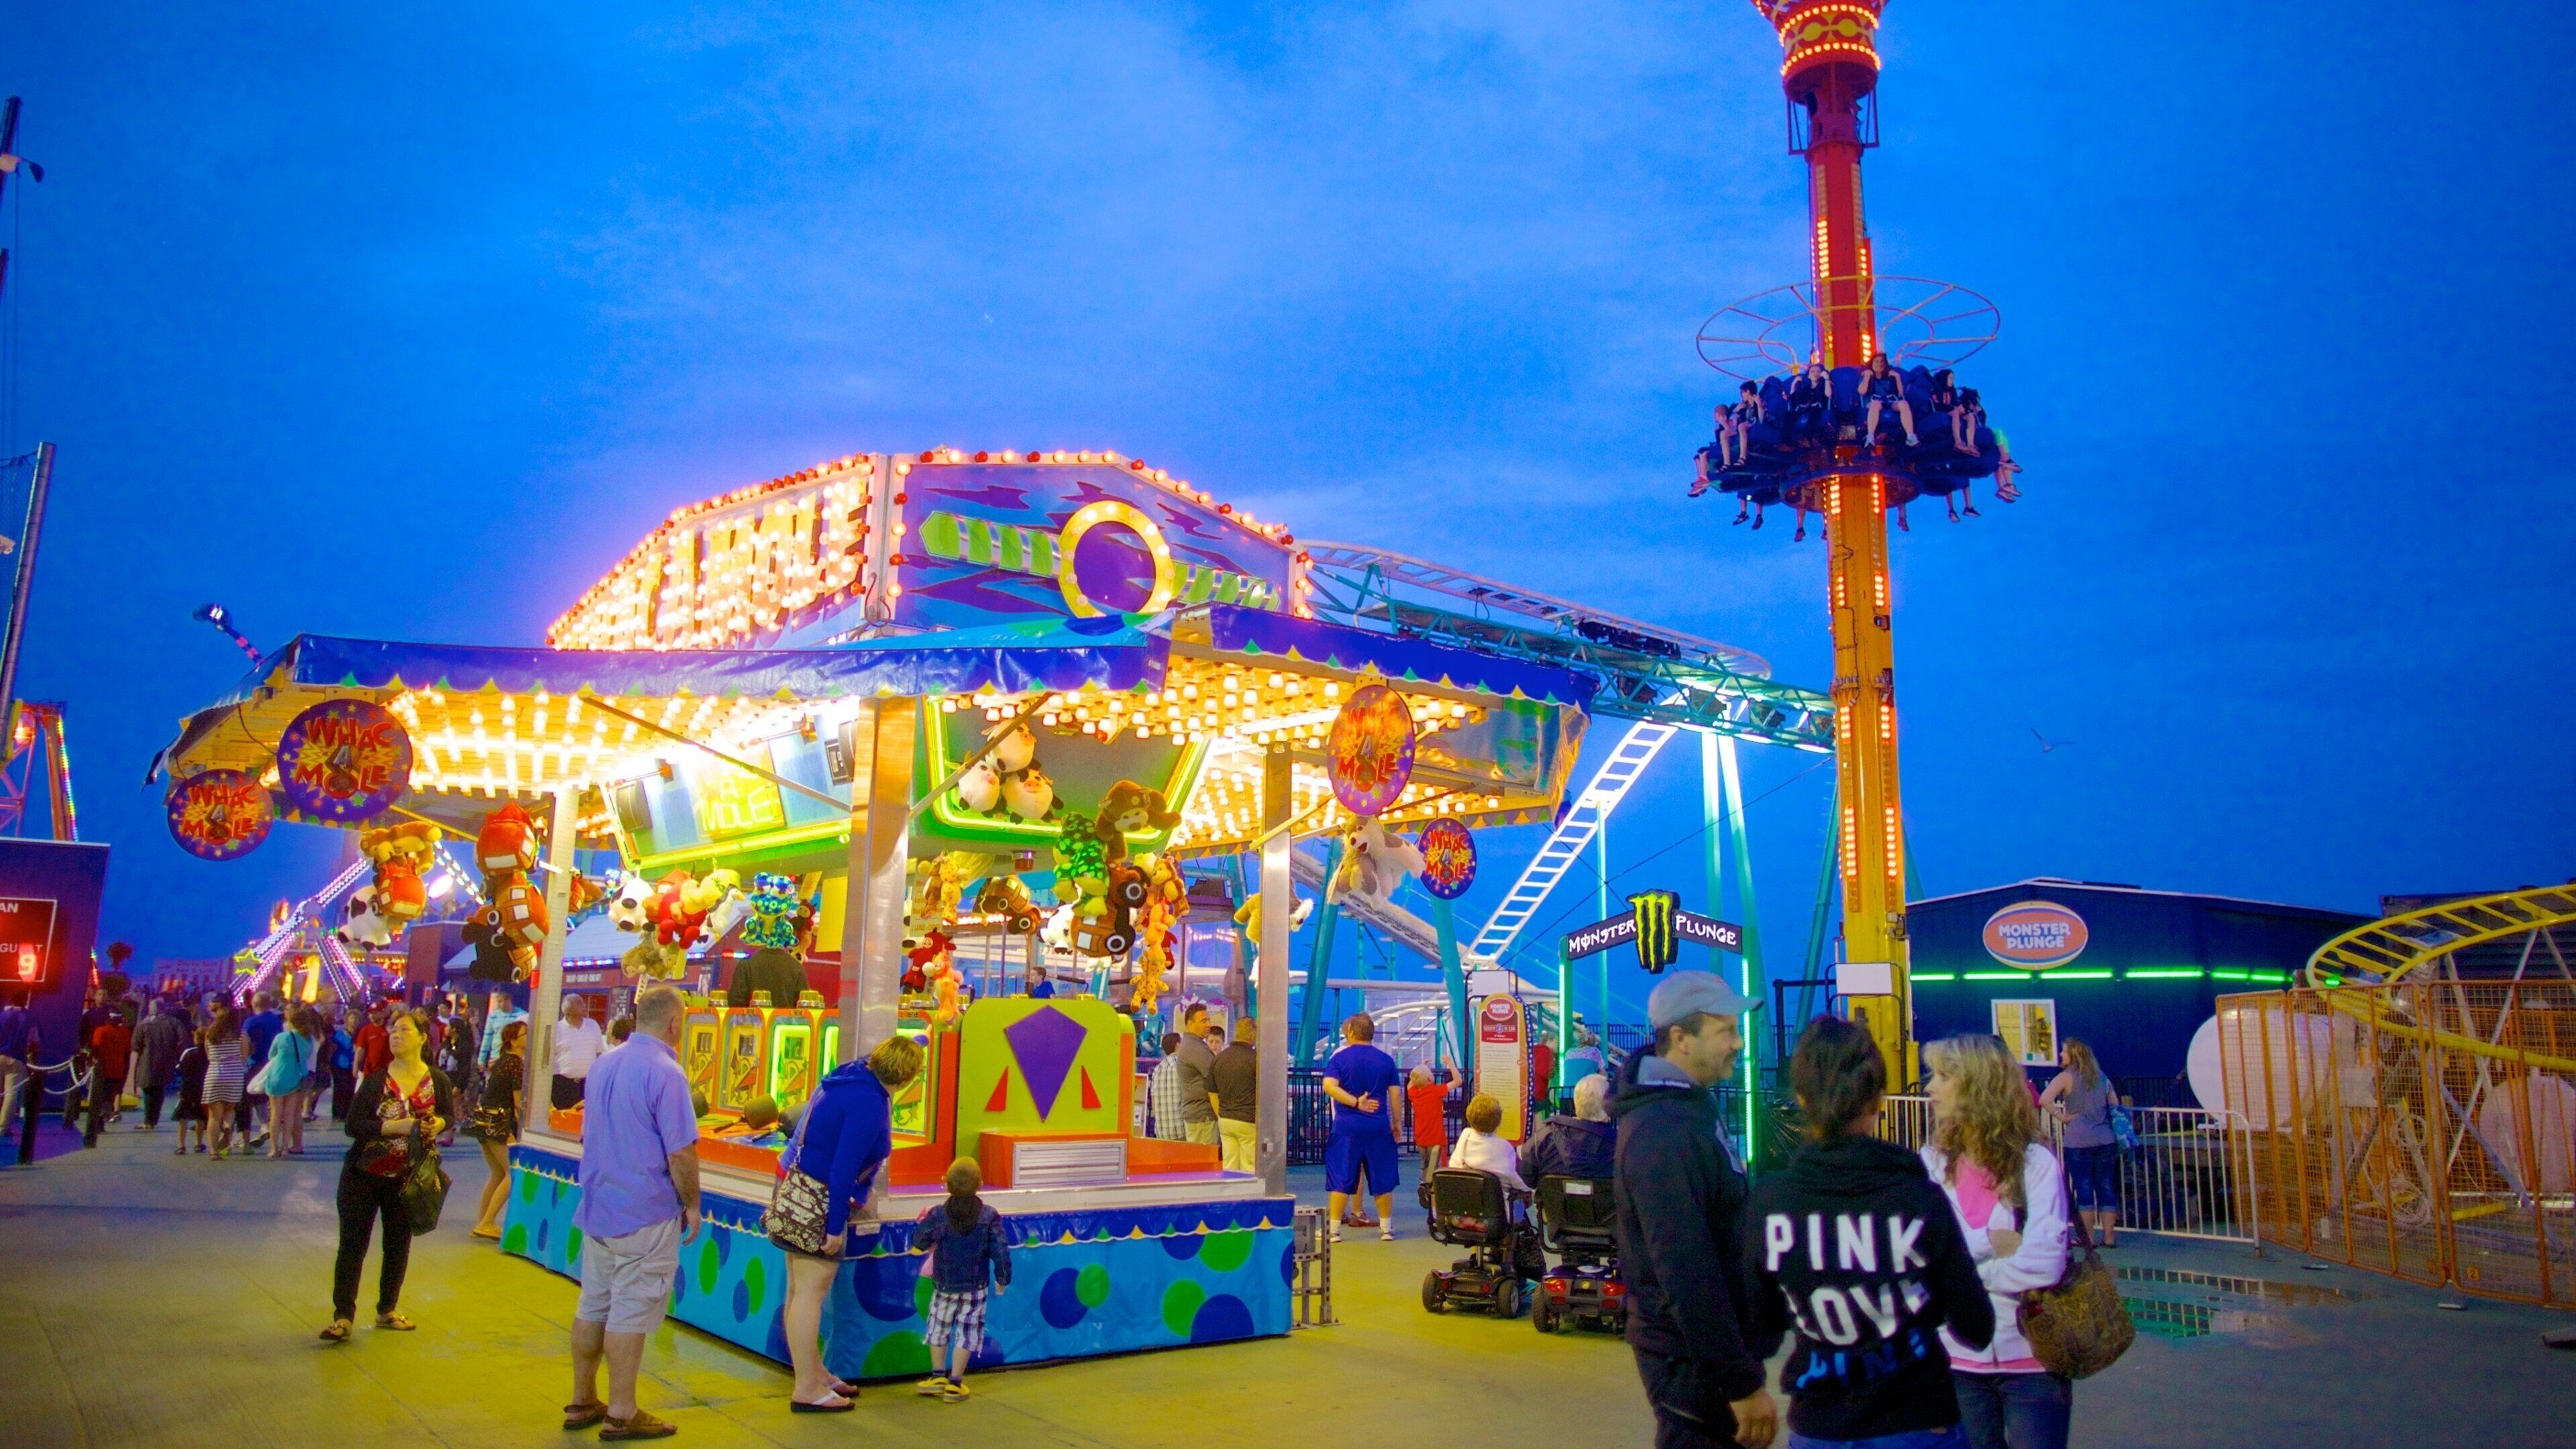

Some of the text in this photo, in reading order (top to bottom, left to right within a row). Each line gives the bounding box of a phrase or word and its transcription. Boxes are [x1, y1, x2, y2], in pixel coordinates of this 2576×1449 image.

[305, 716, 397, 752] WHAC
[294, 762, 392, 800] MOLE
[1336, 753, 1399, 792] MOLE
[187, 784, 259, 808] WHAC
[182, 818, 258, 846] MOLE
[1428, 829, 1468, 851] WHAC
[1426, 861, 1468, 885] MOLE
[1568, 914, 1737, 953] MONSTER PLUNGE
[1998, 922, 2071, 937] MONSTER
[2006, 935, 2065, 950] PLUNGE
[18, 954, 36, 975] 9
[1766, 1214, 1927, 1273] PINK
